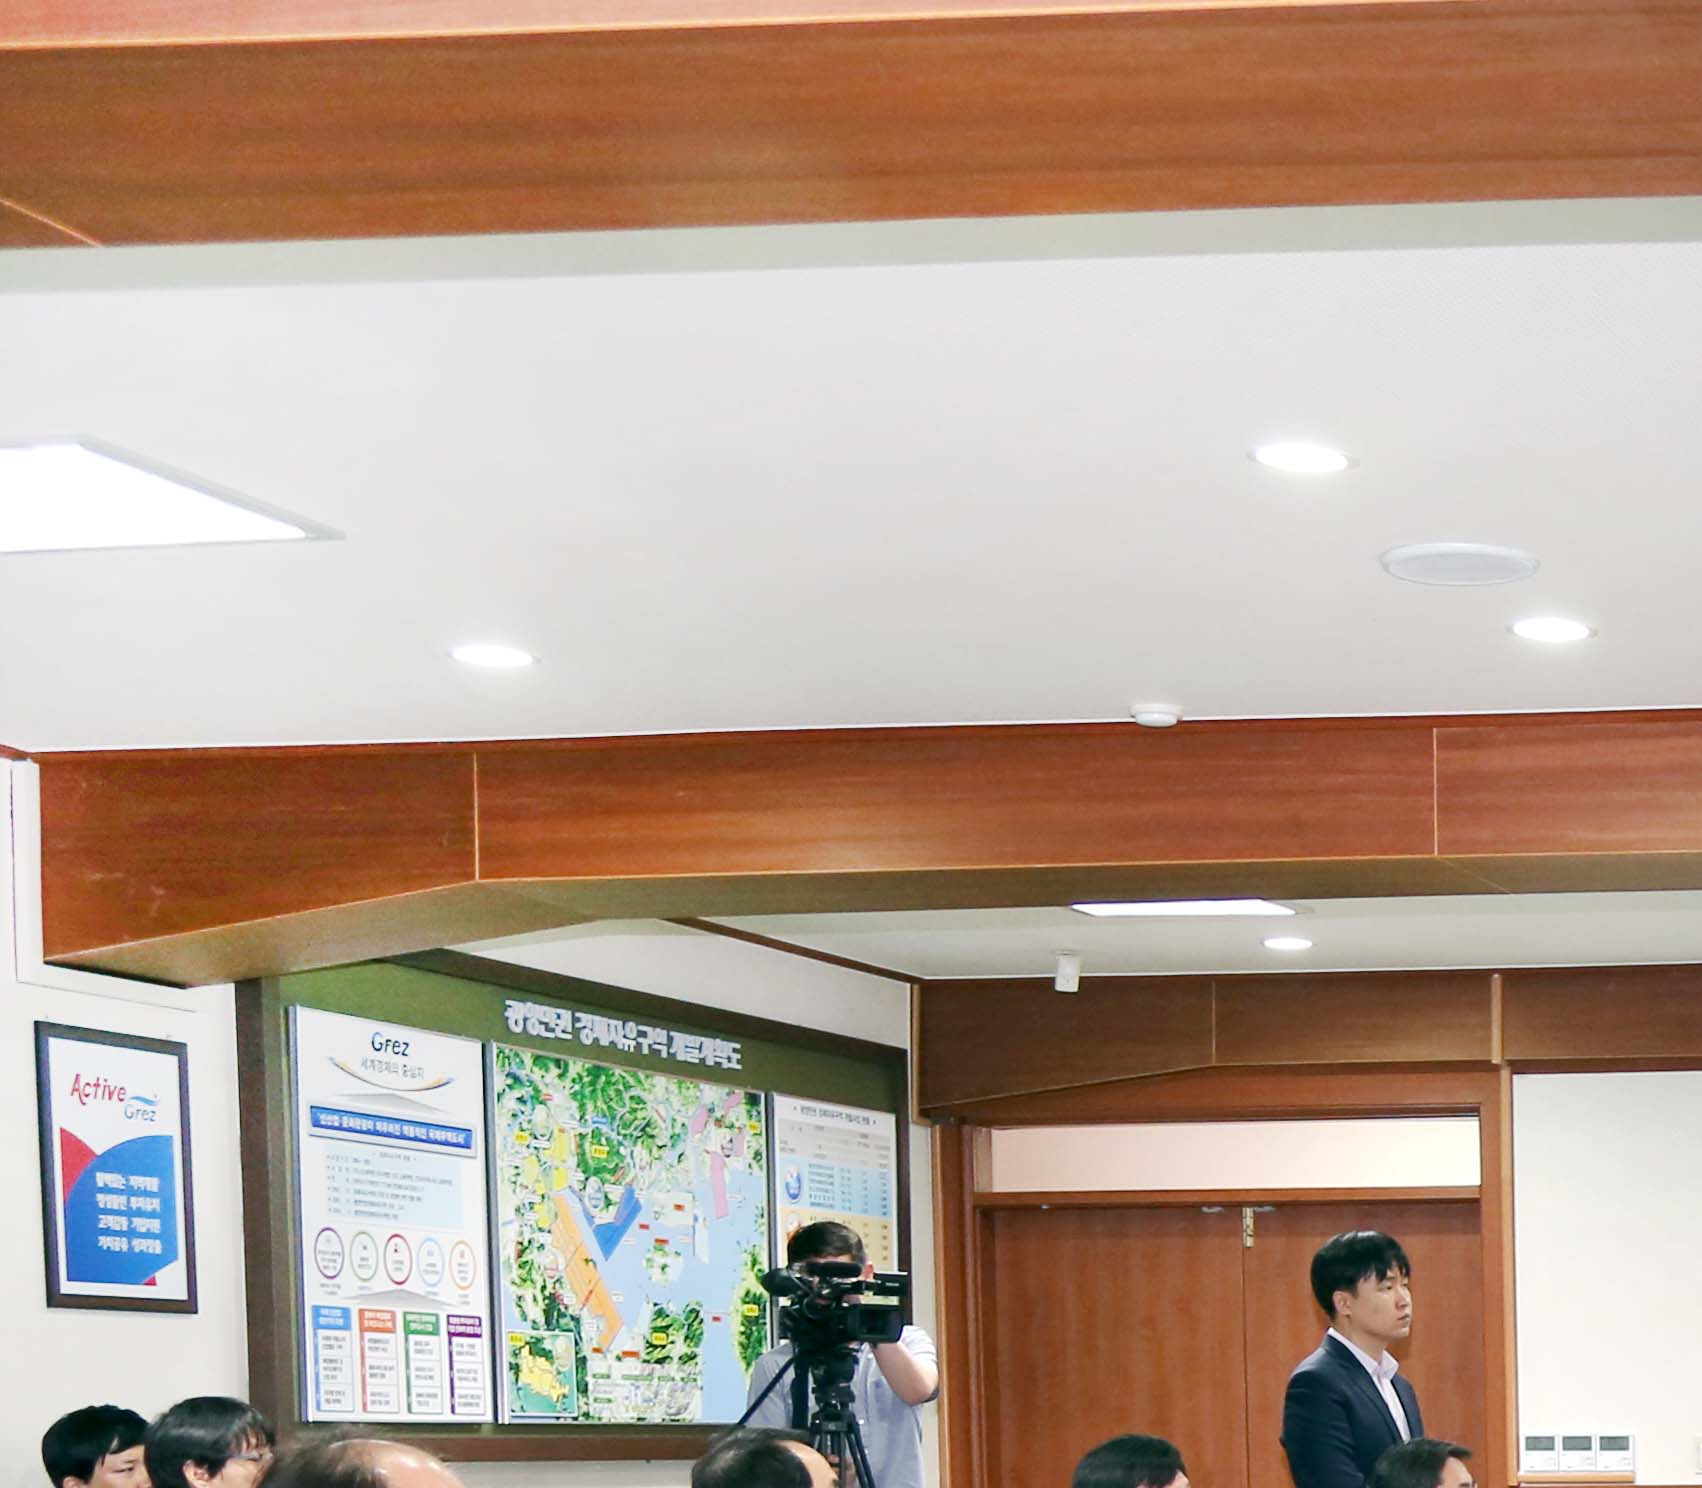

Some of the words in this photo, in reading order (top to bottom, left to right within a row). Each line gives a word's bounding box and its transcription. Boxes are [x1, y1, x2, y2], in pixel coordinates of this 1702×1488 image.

[504, 1000, 573, 1040] 광양만권
[574, 1011, 669, 1059] 경제자유구역
[70, 1073, 128, 1106] Active
